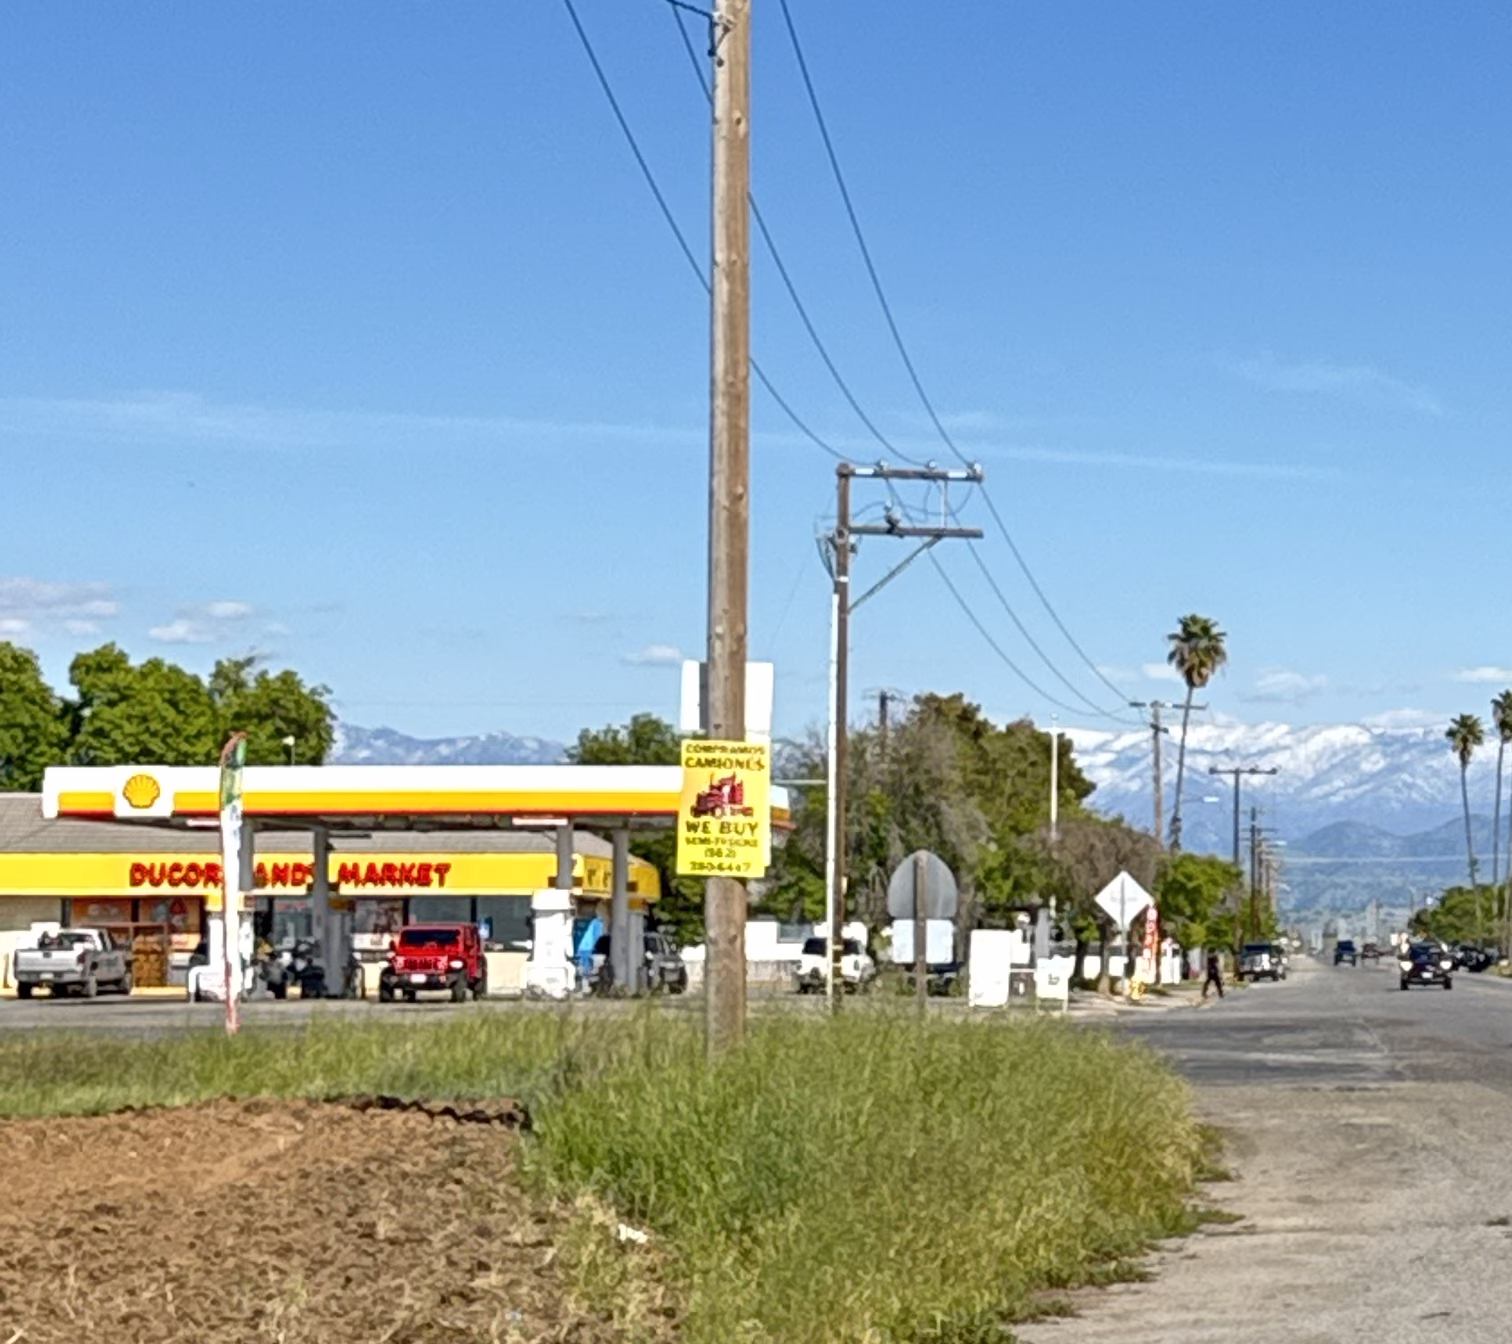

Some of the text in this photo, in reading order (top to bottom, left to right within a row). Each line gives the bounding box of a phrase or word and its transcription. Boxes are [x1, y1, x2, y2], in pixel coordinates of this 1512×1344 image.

[686, 821, 758, 836] WE BUY
[337, 862, 453, 887] MARKET
